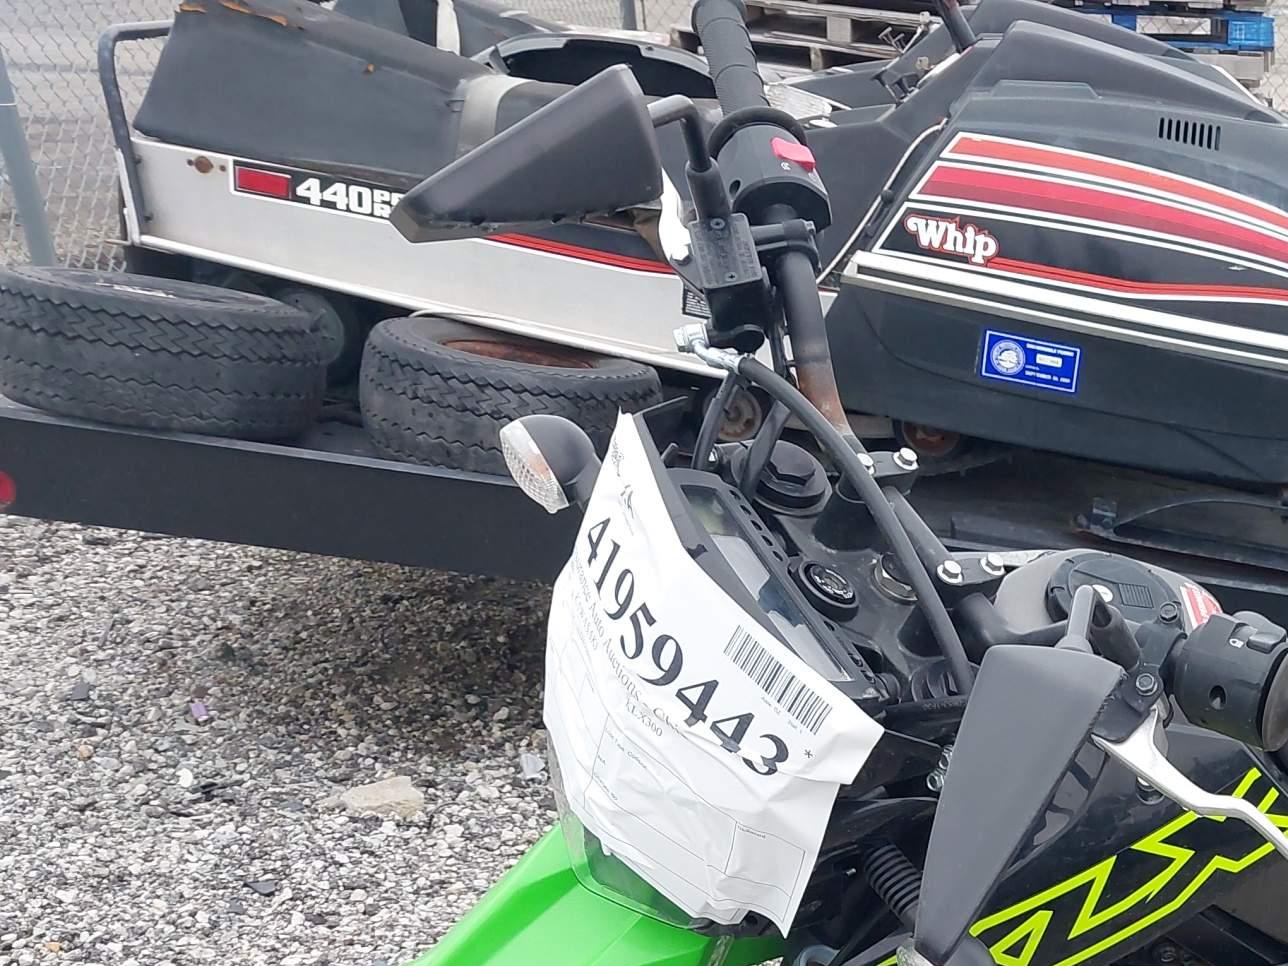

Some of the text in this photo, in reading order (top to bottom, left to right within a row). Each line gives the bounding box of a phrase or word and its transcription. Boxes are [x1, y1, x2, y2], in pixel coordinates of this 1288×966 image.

[296, 177, 373, 215] 440
[905, 215, 998, 264] Whip
[587, 517, 790, 776] 41959443
[603, 637, 642, 702] Auctions
